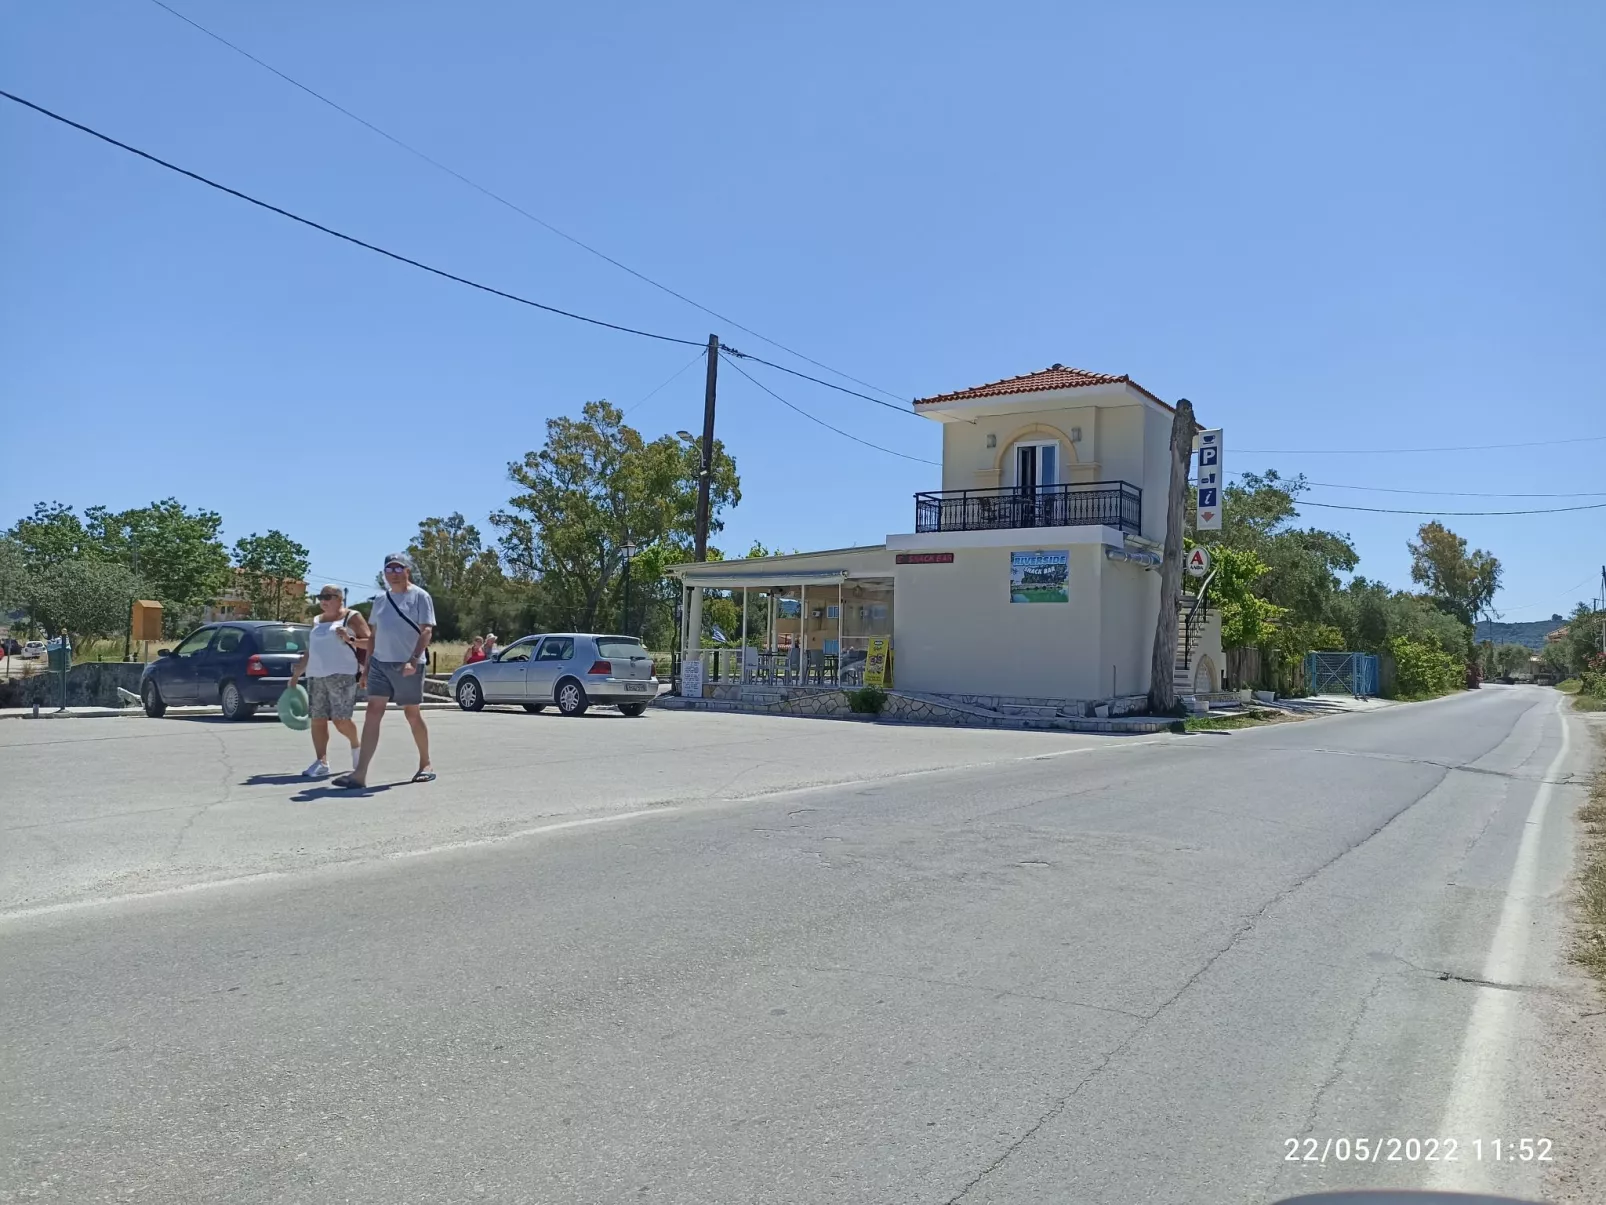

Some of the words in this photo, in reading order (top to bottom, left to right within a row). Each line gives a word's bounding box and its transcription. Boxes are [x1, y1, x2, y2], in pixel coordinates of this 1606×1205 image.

[1203, 449, 1216, 464] P
[908, 555, 934, 563] SNACK
[936, 554, 952, 562] BAR
[1013, 556, 1066, 565] RIVERSIDE
[1190, 551, 1203, 564] A
[1023, 566, 1042, 574] SNACK
[1043, 566, 1056, 574] BAR
